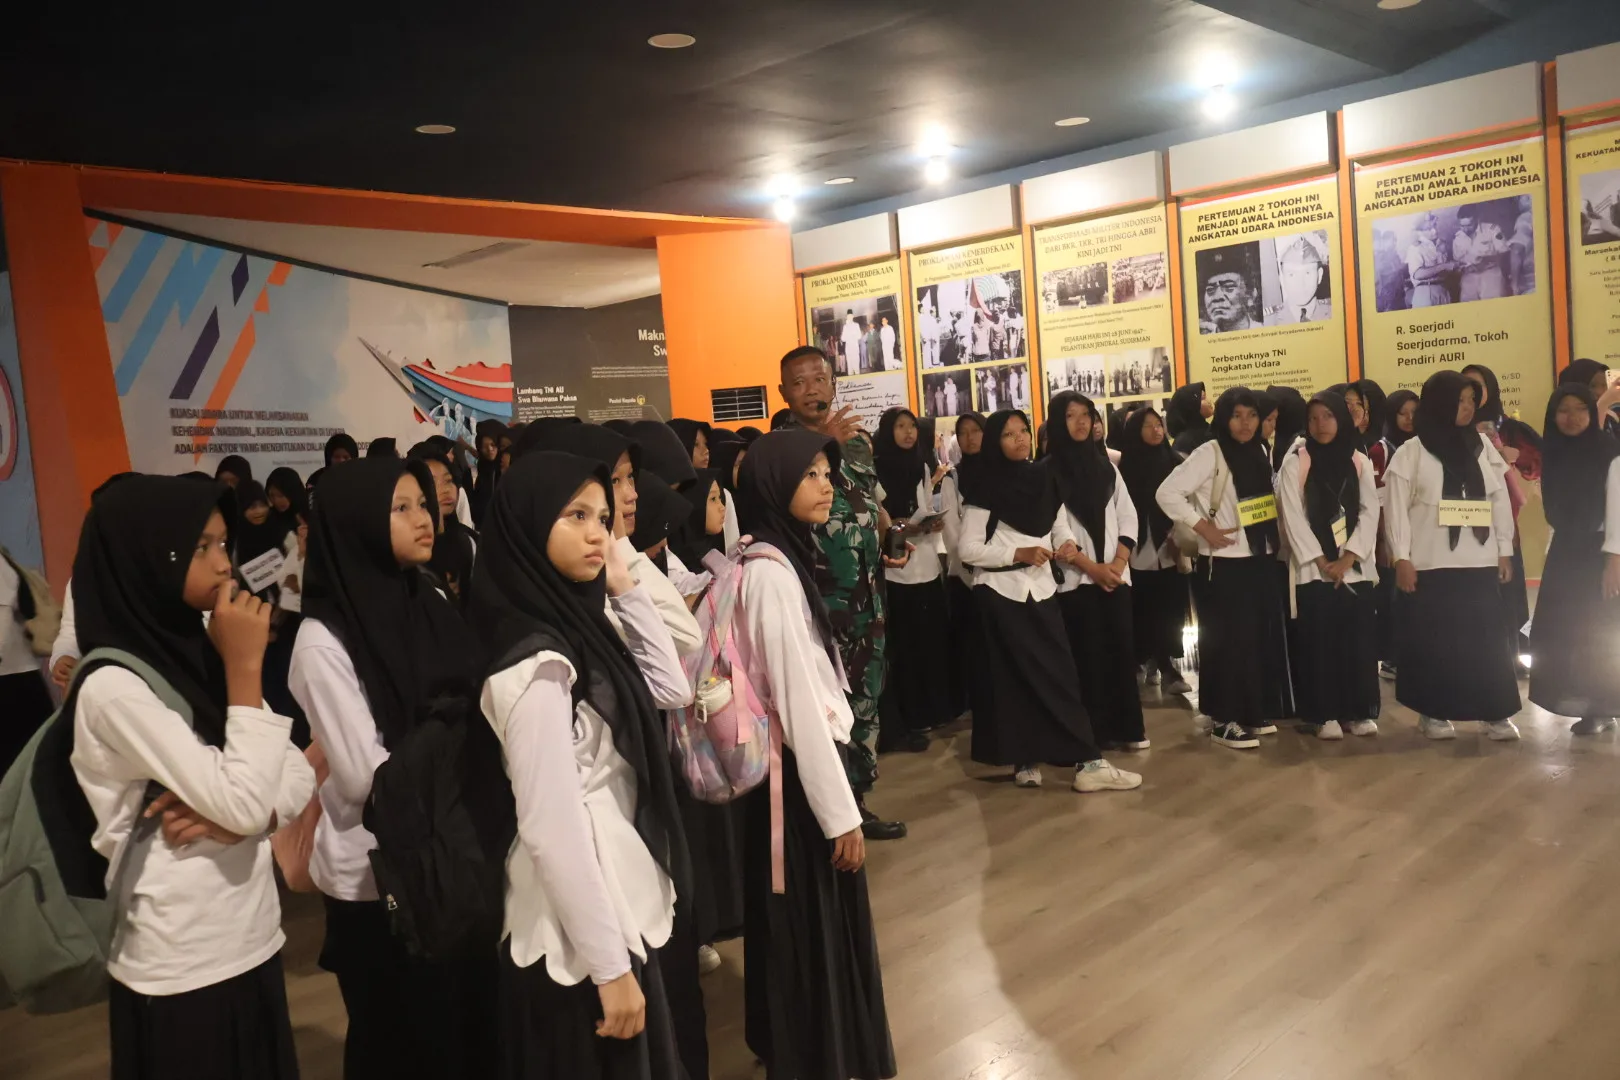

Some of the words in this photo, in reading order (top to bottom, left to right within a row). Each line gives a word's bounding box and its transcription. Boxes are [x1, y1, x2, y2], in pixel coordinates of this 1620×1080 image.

[1376, 168, 1446, 188] PERTEMUAN
[1449, 167, 1456, 175] 2
[1461, 157, 1502, 172] TOKOH
[1506, 153, 1524, 165] INI
[1374, 183, 1424, 199] MENJADI
[1428, 177, 1461, 190] AWAL
[1465, 164, 1527, 183] LAHIRNYA
[1364, 193, 1425, 212] ANGKATAN
[1428, 185, 1468, 200] UDARA
[1472, 173, 1541, 193] INDONESIA
[1198, 205, 1256, 222] PERTEMUAN
[1258, 203, 1265, 211] 2
[1267, 196, 1302, 209] TOKOH
[1305, 193, 1320, 202] INI
[1196, 218, 1238, 232] MENJADI
[1241, 214, 1269, 224] AWAL
[1271, 203, 1323, 219] LAHIRNYA
[1038, 229, 1090, 244] TRANSFORMASI
[1121, 215, 1163, 228] INDONESIA
[1188, 228, 1239, 243] ANGKATAN
[1241, 220, 1275, 233] UDARA
[1277, 211, 1334, 228] INDONESIA
[1045, 244, 1061, 254] DARI
[1096, 236, 1107, 244] TRI
[1108, 231, 1137, 242] HINGGA
[1138, 227, 1156, 236] ABRI
[962, 242, 1015, 258] KEMERDEKAAN
[1077, 249, 1092, 259] KINI
[1093, 246, 1109, 257] JADI
[1109, 244, 1122, 252] TNI
[947, 257, 984, 271] INDONESIA
[811, 275, 848, 288] PROKLAMASI
[848, 266, 894, 280] KEMERDEKAAN
[836, 279, 868, 292] INDONESIA
[638, 329, 666, 341] Makn
[1396, 326, 1406, 335] R.
[1409, 320, 1455, 334] Soerjadi
[1060, 343, 1094, 352] PELANTIKAN
[1120, 336, 1151, 345] SUDIRMAN
[1064, 334, 1087, 344] SEJARAH
[1088, 332, 1101, 341] HARI
[1101, 331, 1111, 339] INI
[1118, 329, 1132, 338] JUNI
[1474, 330, 1509, 343] Tokoh
[653, 344, 668, 357] Sw
[1211, 351, 1270, 363] Terbentuknya
[1272, 348, 1287, 357] TNI
[1397, 354, 1436, 367] Pendiri
[1439, 351, 1465, 363] AURI
[1211, 362, 1253, 374] Angkatan
[1255, 360, 1281, 369] Udara
[516, 387, 543, 395] Lambang
[532, 395, 558, 403] Bhuwana
[559, 394, 577, 402] Paksa
[169, 408, 200, 419] KUASAI
[228, 410, 254, 420] UNTUK
[256, 426, 284, 437] KARENA
[285, 427, 318, 437] KEKUATAN
[174, 443, 208, 454] ADALAH
[208, 443, 239, 454] FAKTOR
[239, 443, 260, 453] YANG
[260, 442, 306, 453] MENENTUKAN
[306, 442, 326, 452] DALA
